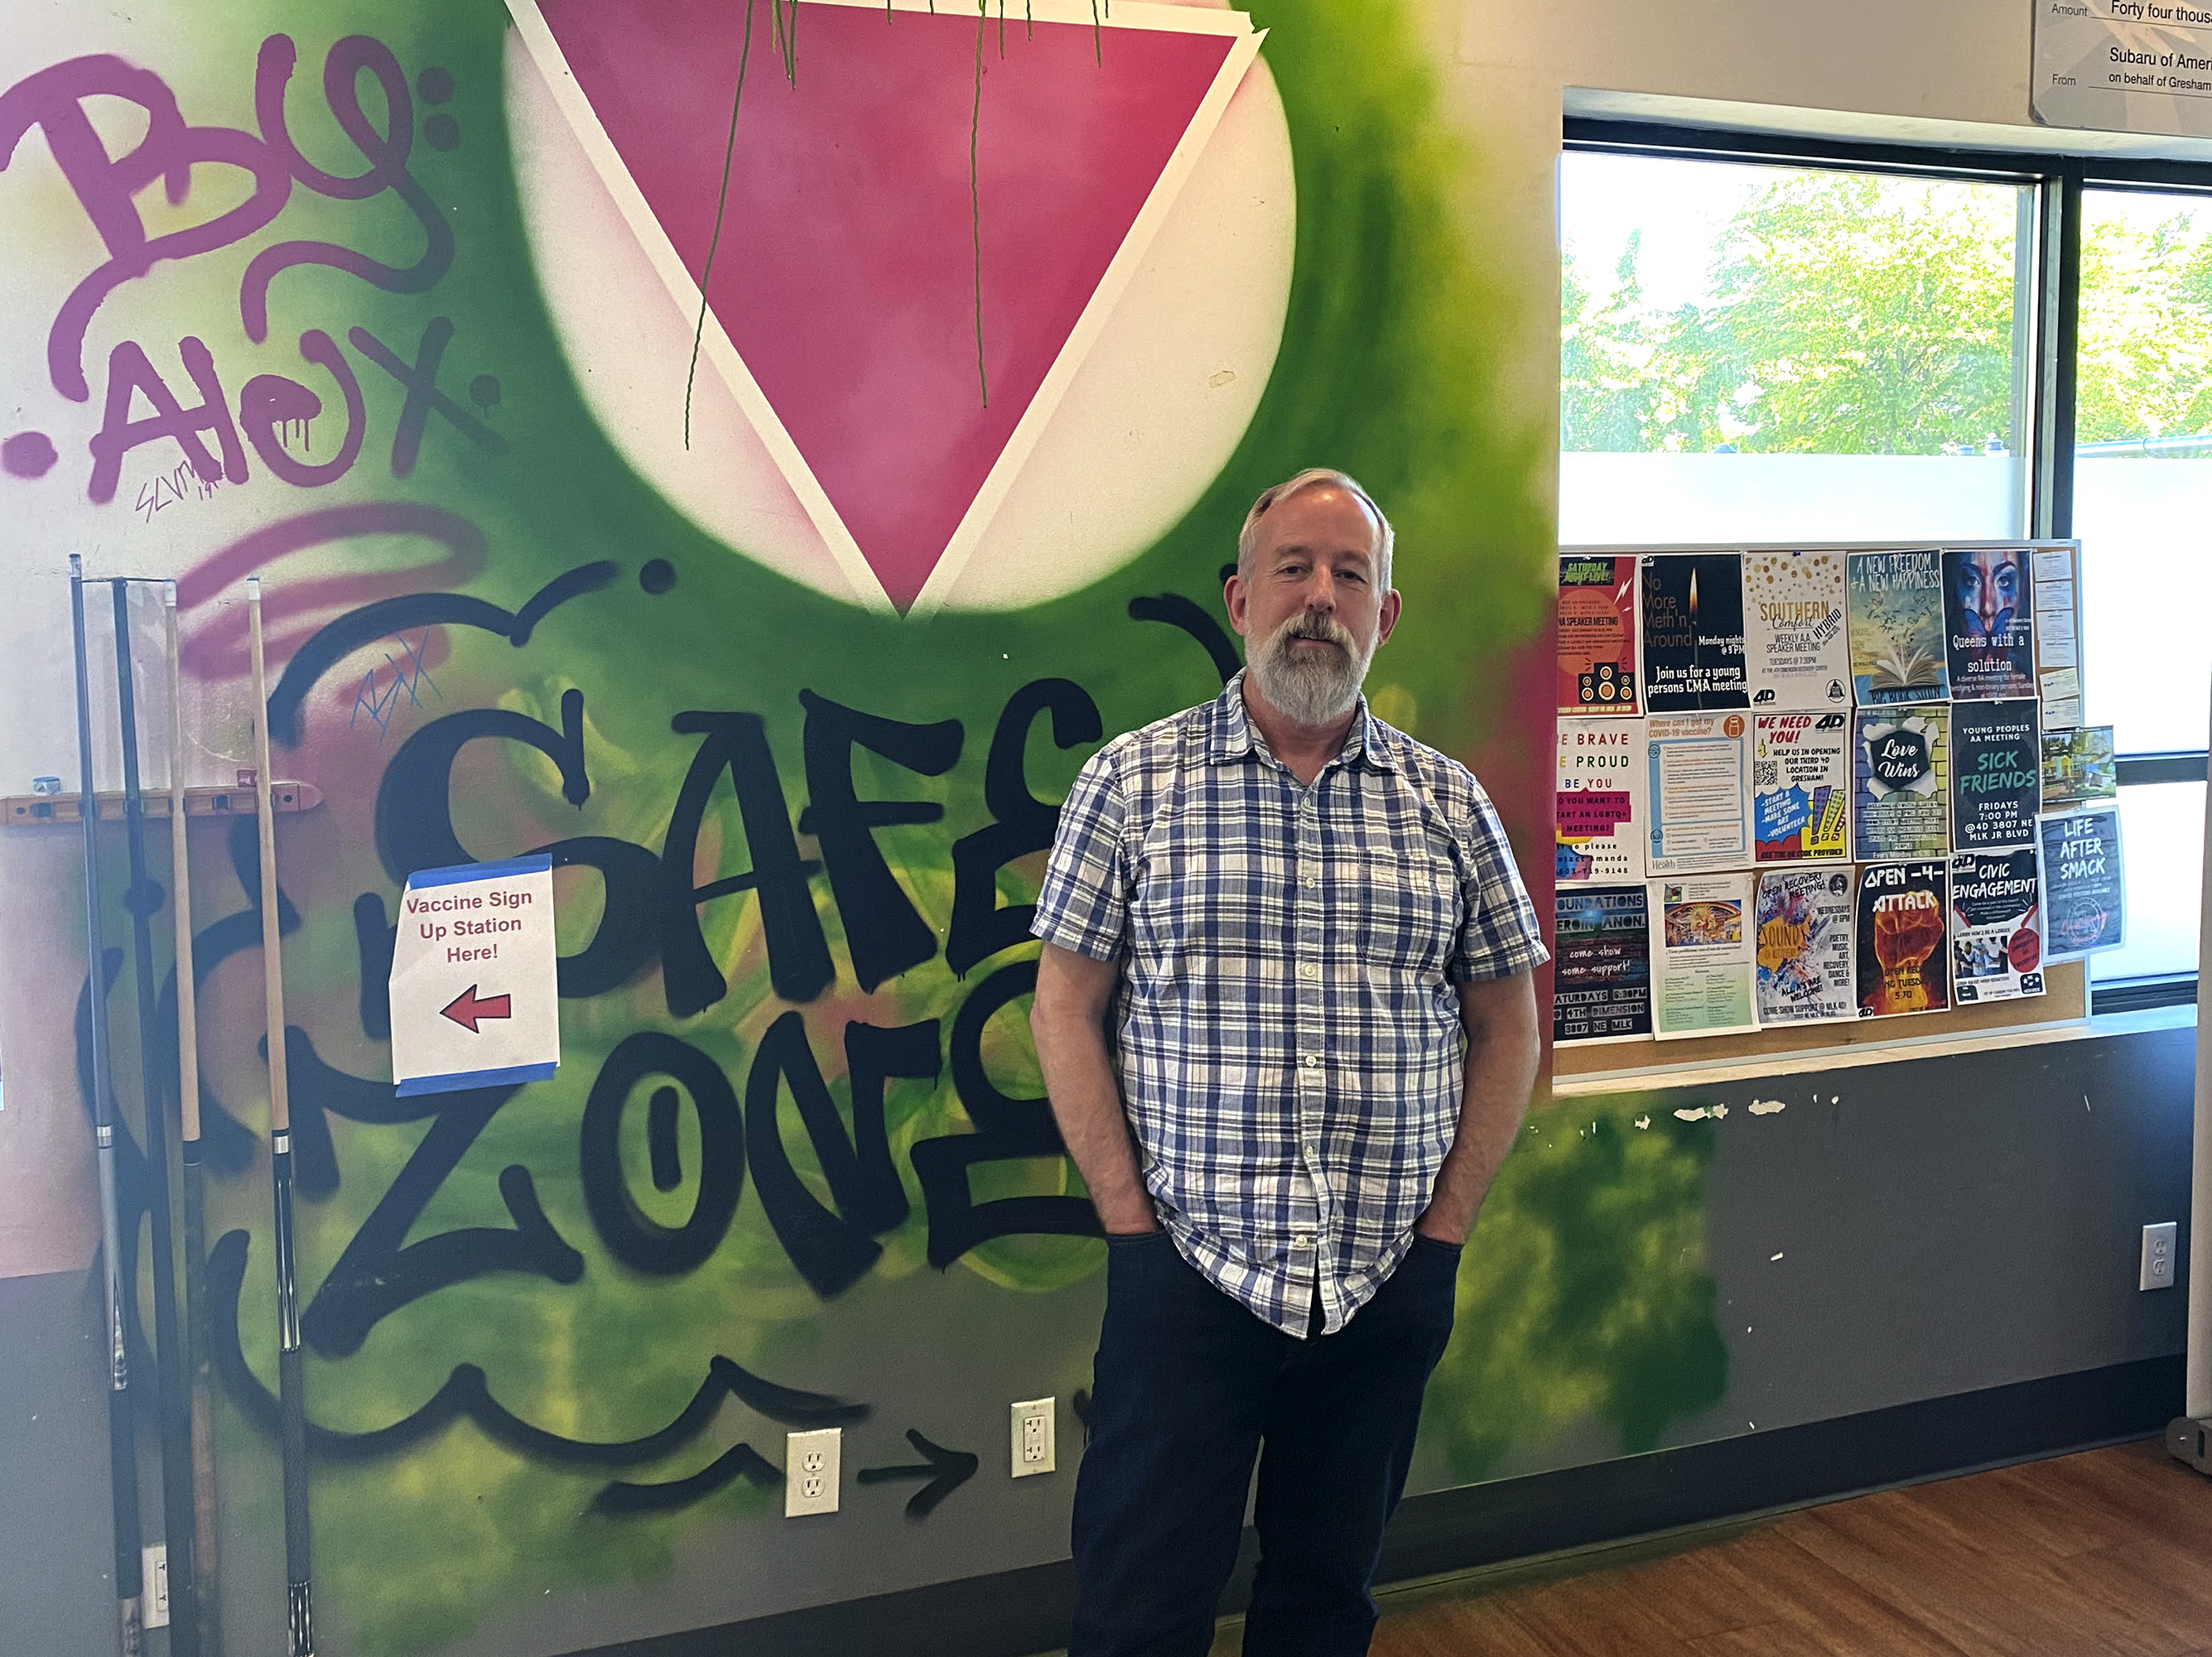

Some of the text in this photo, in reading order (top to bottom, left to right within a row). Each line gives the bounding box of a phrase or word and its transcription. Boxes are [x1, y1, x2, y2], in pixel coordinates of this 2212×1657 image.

[2052, 4, 2088, 16] Amount
[2112, 0, 2212, 23] Forty four thous
[2110, 47, 2156, 65] Subaru
[2161, 53, 2173, 66] of
[2052, 74, 2075, 85] From
[2109, 73, 2211, 91] on behalf of Gresham
[1568, 562, 1607, 571] SATURDAY
[1857, 553, 1930, 574] A NEW FREEDOM
[1643, 572, 1660, 590] No
[1868, 570, 1940, 592] NEW HAPPINESS
[1643, 593, 1676, 609] More
[1760, 600, 1829, 621] SOUTHERN
[1567, 617, 1618, 626] SPEAKER MEETING
[1772, 614, 1814, 631] Comfort
[1813, 609, 1841, 639] HYBRID
[1645, 625, 1692, 647] Around
[1699, 635, 1744, 646] Monday nights
[1775, 633, 1798, 643] WEEKLY
[1953, 633, 2024, 650] Queens with a
[1721, 647, 1727, 655] @
[1734, 645, 1745, 654] PM
[1766, 643, 1820, 653] SPEAKER MEETING
[1968, 658, 2012, 672] solution
[1656, 666, 1674, 682] Join
[1677, 670, 1687, 678] us
[1689, 664, 1704, 678] for
[1713, 667, 1740, 680] young
[1648, 678, 1747, 698] persons CMA meeting
[1753, 689, 1775, 702] 4D
[1691, 718, 1702, 727] get
[1704, 718, 1714, 726] my
[1758, 715, 1811, 729] WE NEED
[1815, 715, 1843, 729] 4D
[1769, 730, 1800, 744] YOU!
[1963, 726, 1993, 735] YOUNG
[1578, 734, 1628, 745] BRAVE
[1881, 739, 1918, 759] Love
[1577, 756, 1628, 768] PROUD
[1978, 750, 2018, 771] SICK
[1878, 762, 1920, 778] Wins
[1565, 779, 1611, 788] BE YOU
[1960, 769, 2036, 795] FRIENDS
[1978, 801, 2018, 811] FRIDAYS
[1777, 816, 1789, 826] ART
[1979, 812, 2001, 821] 7:00
[1965, 822, 1988, 833] @4D
[1993, 821, 2017, 829] 3807
[2065, 817, 2094, 837] LIFE
[1970, 832, 1988, 841] MLK
[2006, 829, 2028, 838] BLVD
[2060, 837, 2104, 860] AFTER
[1652, 860, 1675, 869] Health
[1979, 863, 2010, 879] CIVIC
[2060, 857, 2105, 879] SMACK
[1762, 872, 1822, 899] OPEN RECOVERY
[1953, 878, 2037, 899] ENGAGEMENT
[407, 891, 533, 914] Vaccine Sign
[1557, 895, 1643, 910] OUNDATIONS
[1872, 892, 1935, 913] ATTACK
[1817, 905, 1850, 915] WEDNESDAYS
[420, 918, 522, 941] Up Station
[1557, 916, 1645, 931] EROIN ANON.
[447, 944, 498, 963] Here!
[1598, 946, 1621, 956] show
[1562, 967, 1587, 975] some
[1555, 992, 1607, 1004] ATURDAYS
[1781, 987, 1795, 996] ALL
[1568, 1004, 1644, 1018] 4TH DIMENSION
[1780, 1005, 1794, 1014] SHOW
[1795, 1004, 1818, 1013] SUPPORT
[1612, 1020, 1631, 1029] MLK
